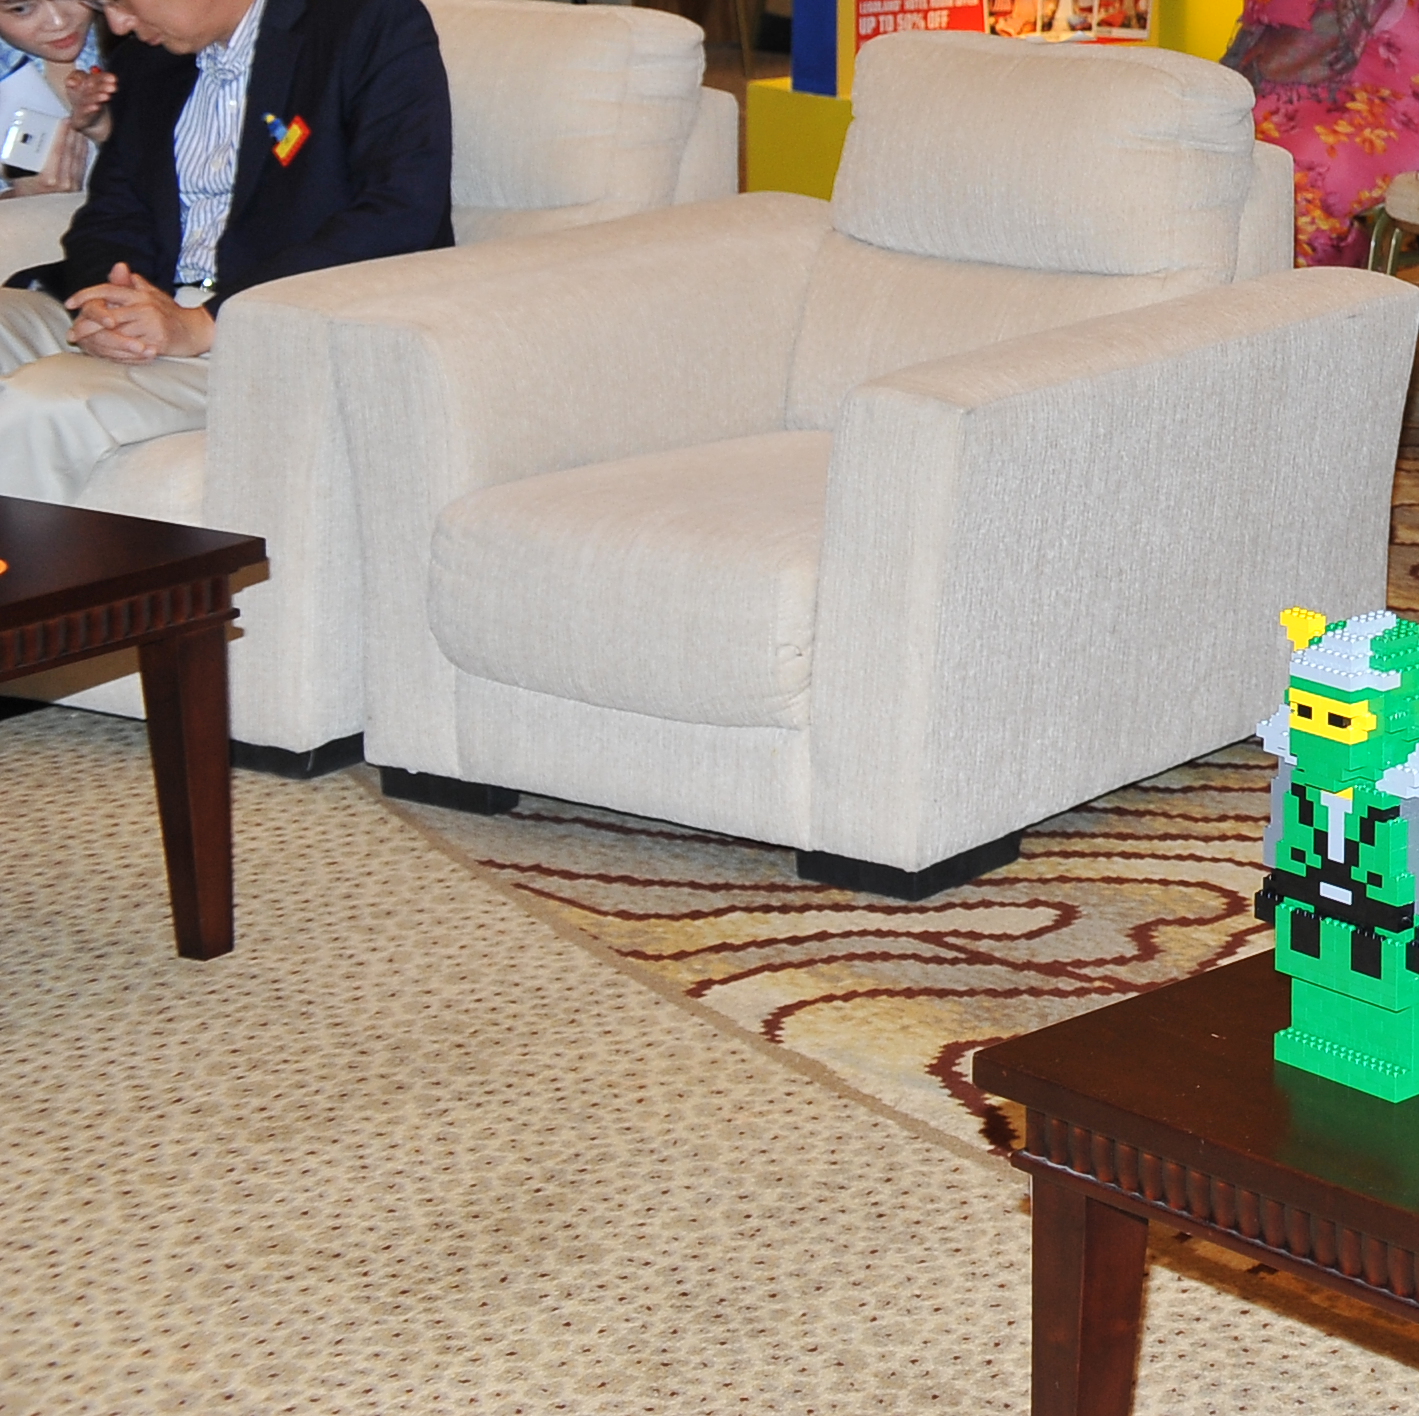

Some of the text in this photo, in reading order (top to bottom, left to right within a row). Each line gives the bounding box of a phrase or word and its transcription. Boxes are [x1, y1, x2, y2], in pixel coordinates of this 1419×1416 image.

[858, 15, 877, 36] UP
[878, 14, 895, 33] TO
[926, 9, 951, 30] OFF
